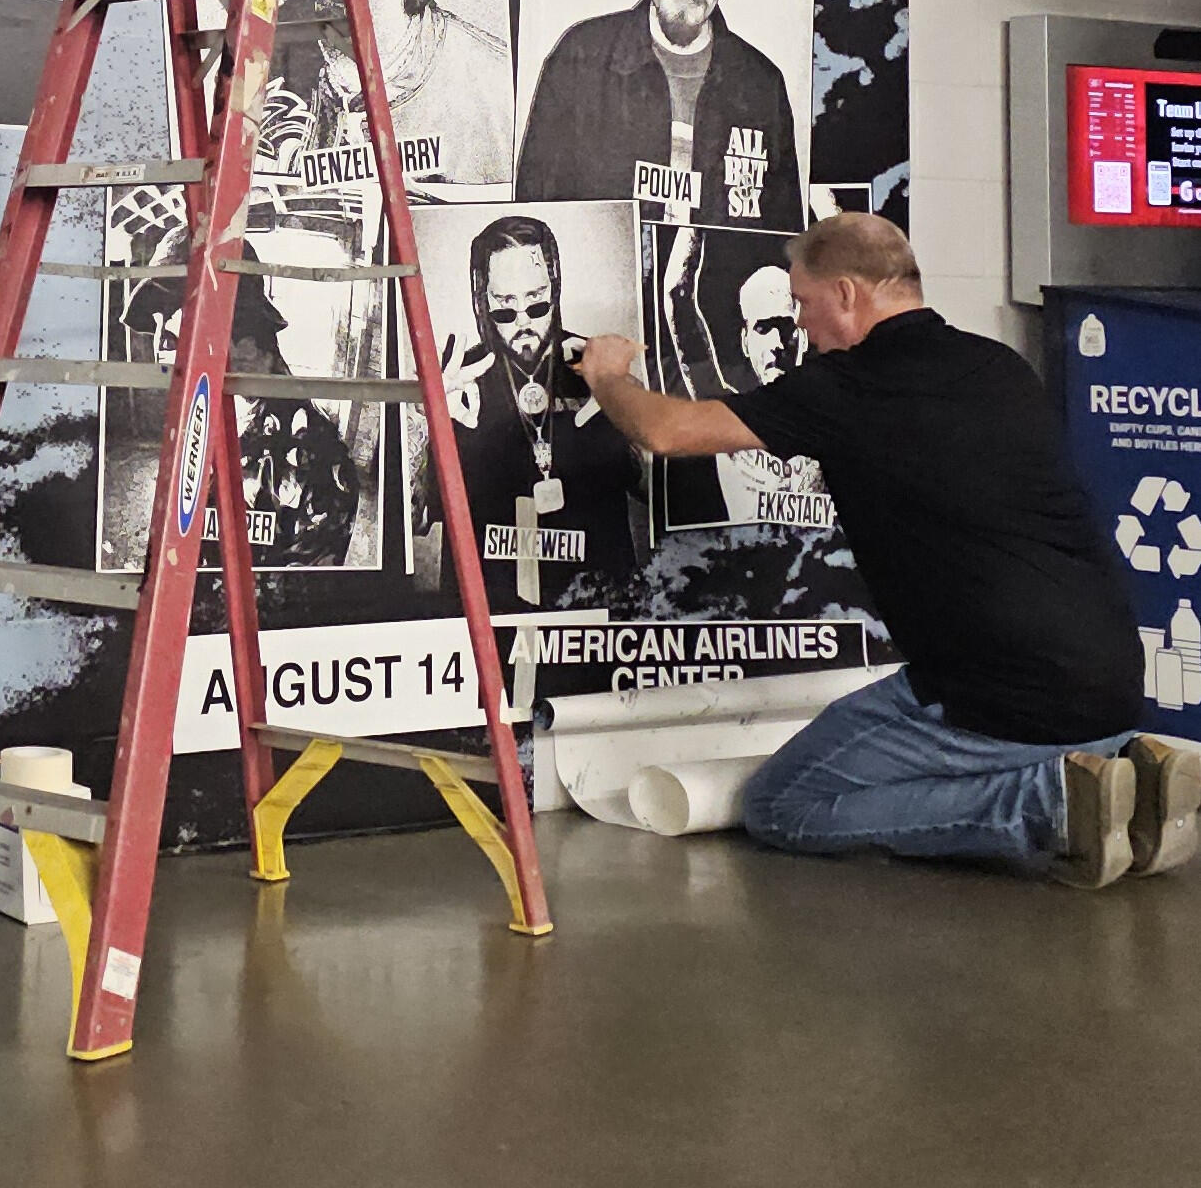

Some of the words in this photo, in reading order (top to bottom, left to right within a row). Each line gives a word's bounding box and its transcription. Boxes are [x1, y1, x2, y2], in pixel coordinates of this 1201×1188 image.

[302, 146, 375, 188] DENZEL
[398, 136, 441, 173] RRY
[726, 126, 768, 160] ALL
[638, 165, 692, 203] POUYA
[727, 186, 763, 218] SIX
[183, 404, 204, 502] WERNER
[757, 492, 833, 525] EKKSTACY
[508, 627, 685, 665] AMERICAN
[694, 625, 839, 661] AIRLINES
[200, 654, 402, 715] AGUST
[417, 651, 465, 696] 14
